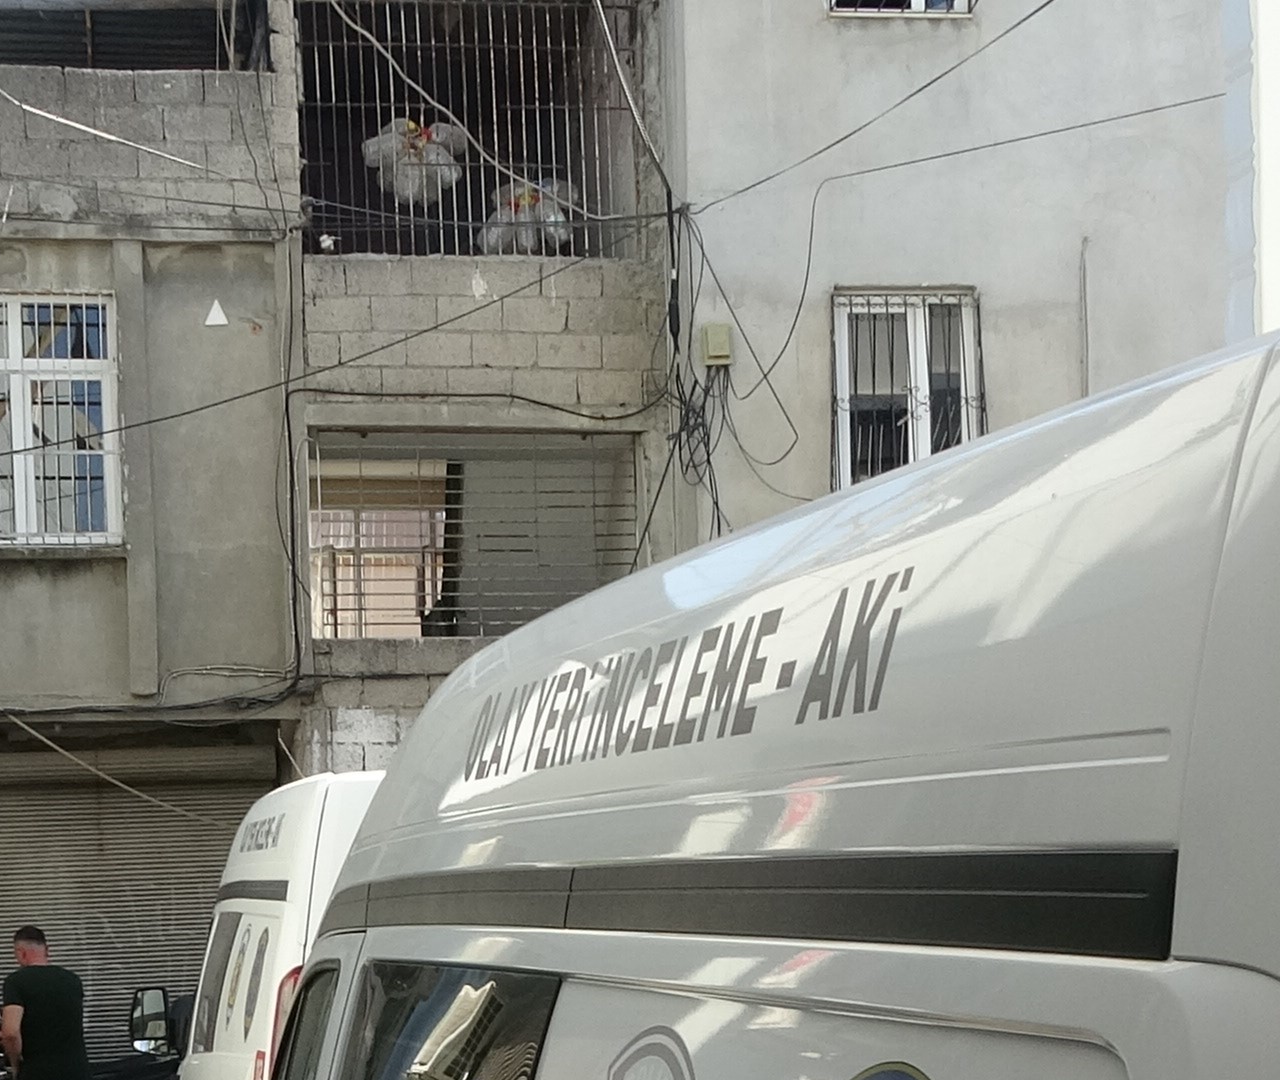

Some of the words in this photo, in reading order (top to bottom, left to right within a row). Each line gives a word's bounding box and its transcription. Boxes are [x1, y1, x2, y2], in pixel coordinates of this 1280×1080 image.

[464, 680, 538, 783] OLAY
[580, 606, 784, 763] İNCELEME
[794, 566, 915, 725] AKİ
